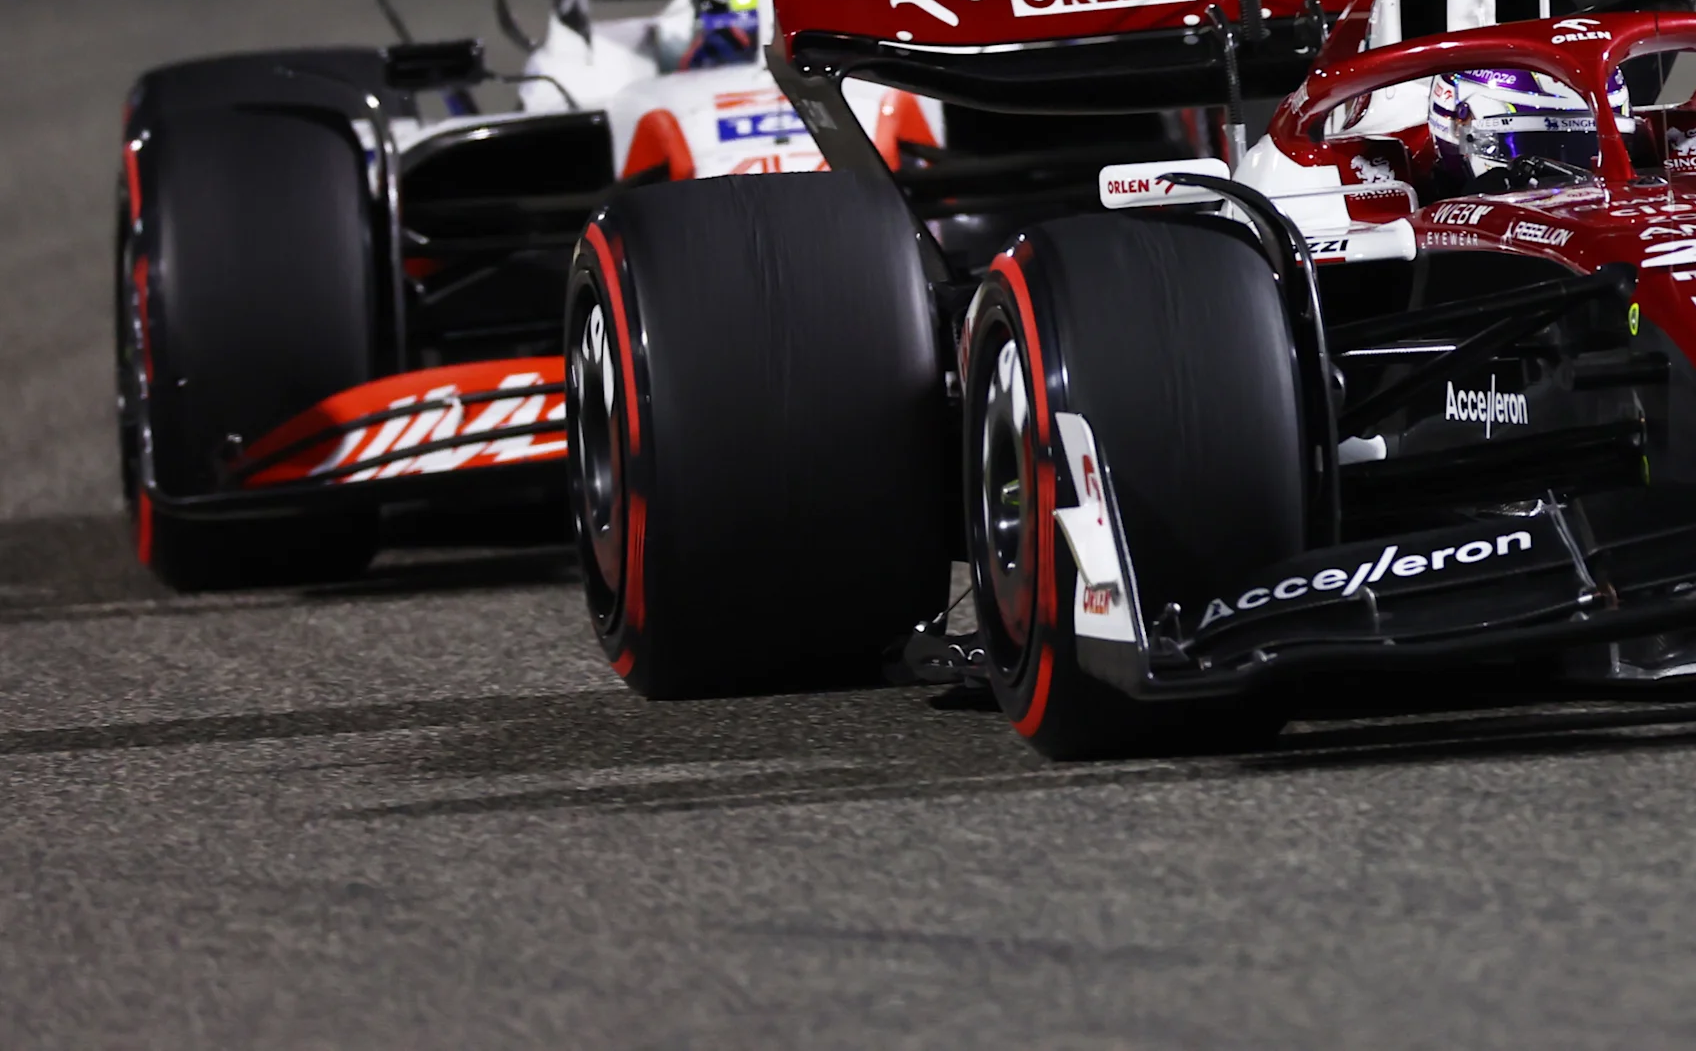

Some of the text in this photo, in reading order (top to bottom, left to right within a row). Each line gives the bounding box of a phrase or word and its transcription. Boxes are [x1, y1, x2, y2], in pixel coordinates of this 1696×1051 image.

[1551, 31, 1612, 44] ORLEN
[1561, 119, 1595, 129] SINGH
[1108, 179, 1149, 194] ORLEN
[1427, 232, 1478, 246] EYEWEAR
[1513, 221, 1575, 247] REBELLION
[1445, 373, 1529, 439] Accelleron
[1198, 530, 1532, 630] Accelleron
